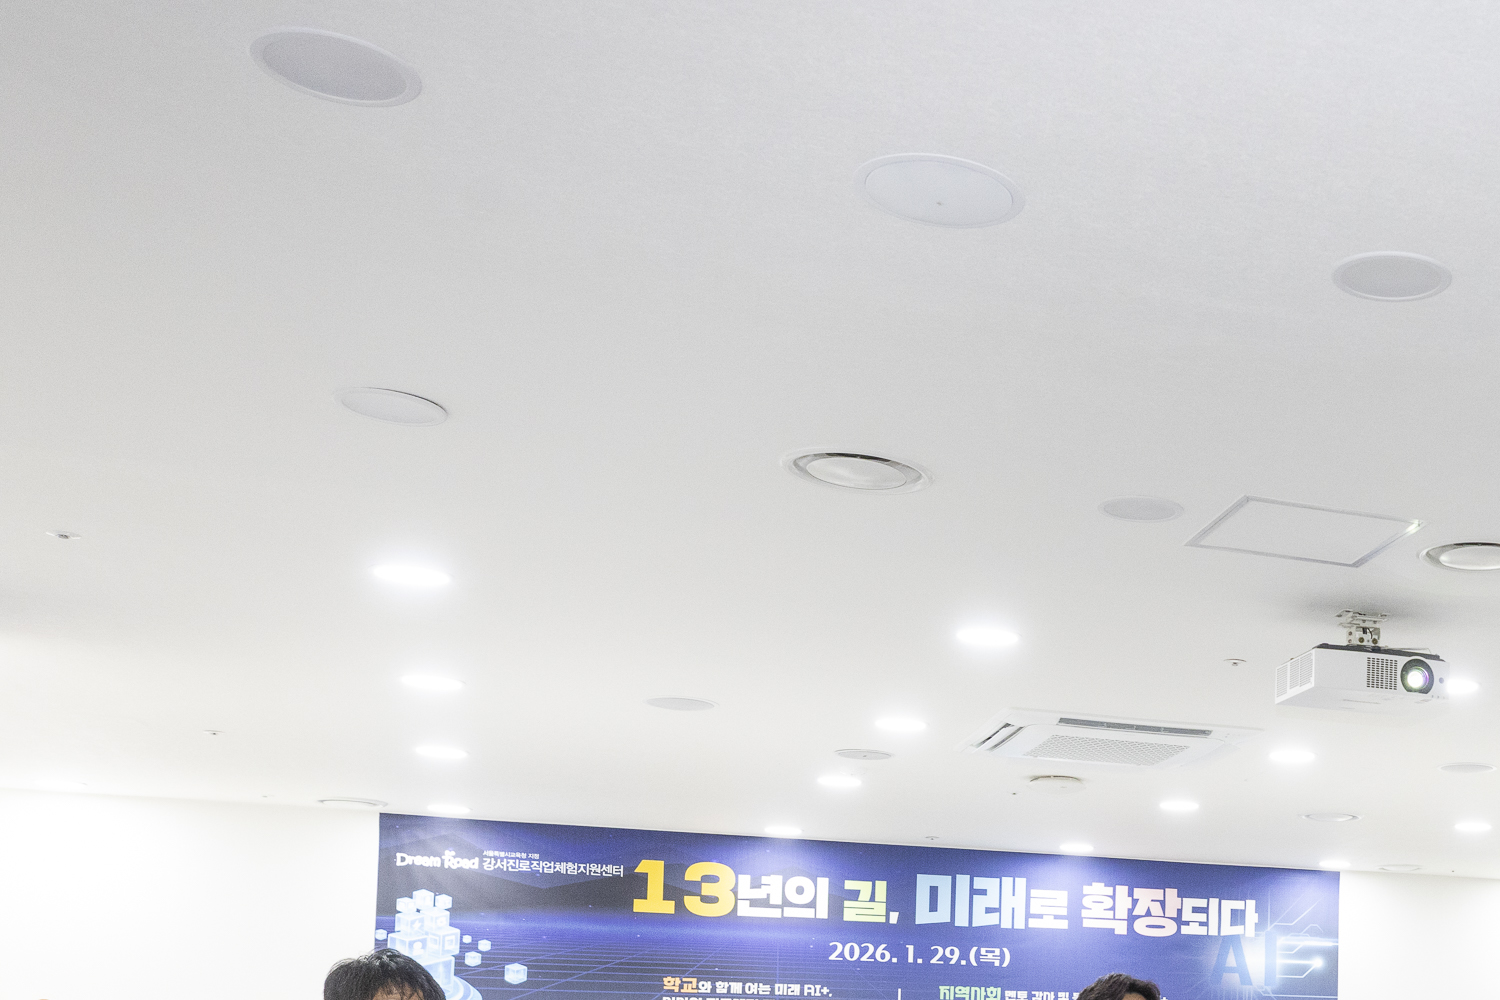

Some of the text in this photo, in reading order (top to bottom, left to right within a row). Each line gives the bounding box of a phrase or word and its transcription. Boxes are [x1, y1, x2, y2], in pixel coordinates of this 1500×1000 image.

[395, 852, 441, 868] Dream
[482, 857, 624, 877] 강서진로직업체험지원센터
[633, 859, 1258, 937] 13년의 길, 미래로 확장되다
[828, 941, 898, 963] 2026.
[905, 944, 923, 964] 1.
[662, 976, 712, 994] 학교와
[715, 981, 743, 995] 함께
[745, 982, 771, 996] 여는
[774, 982, 801, 997] 미래
